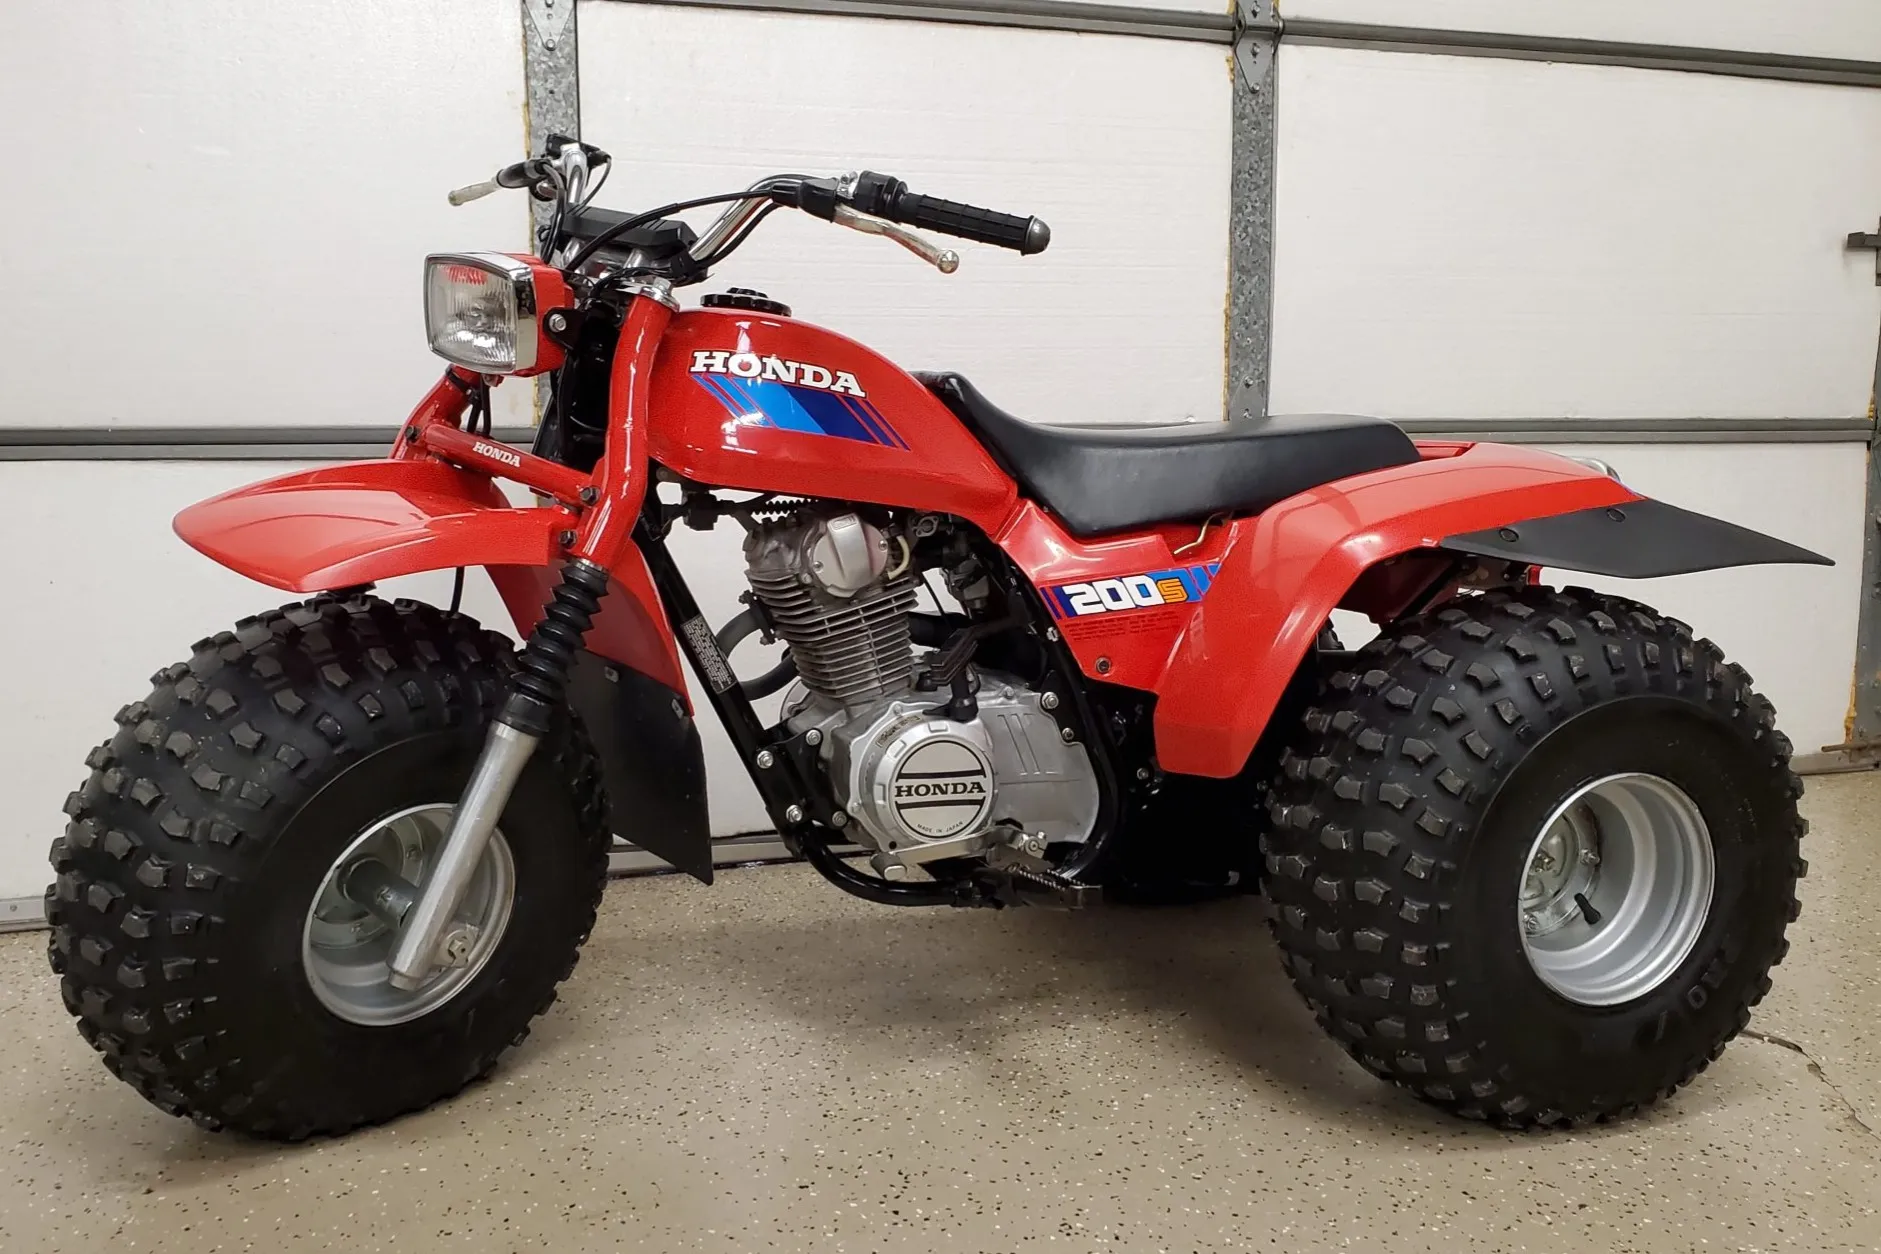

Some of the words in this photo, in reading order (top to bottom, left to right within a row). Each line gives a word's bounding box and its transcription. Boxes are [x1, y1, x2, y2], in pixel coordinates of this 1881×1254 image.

[690, 351, 866, 398] HONDA
[472, 441, 521, 468] HONDA
[895, 782, 986, 798] HONDA
[917, 823, 932, 833] MADE
[946, 821, 963, 833] JAPAN
